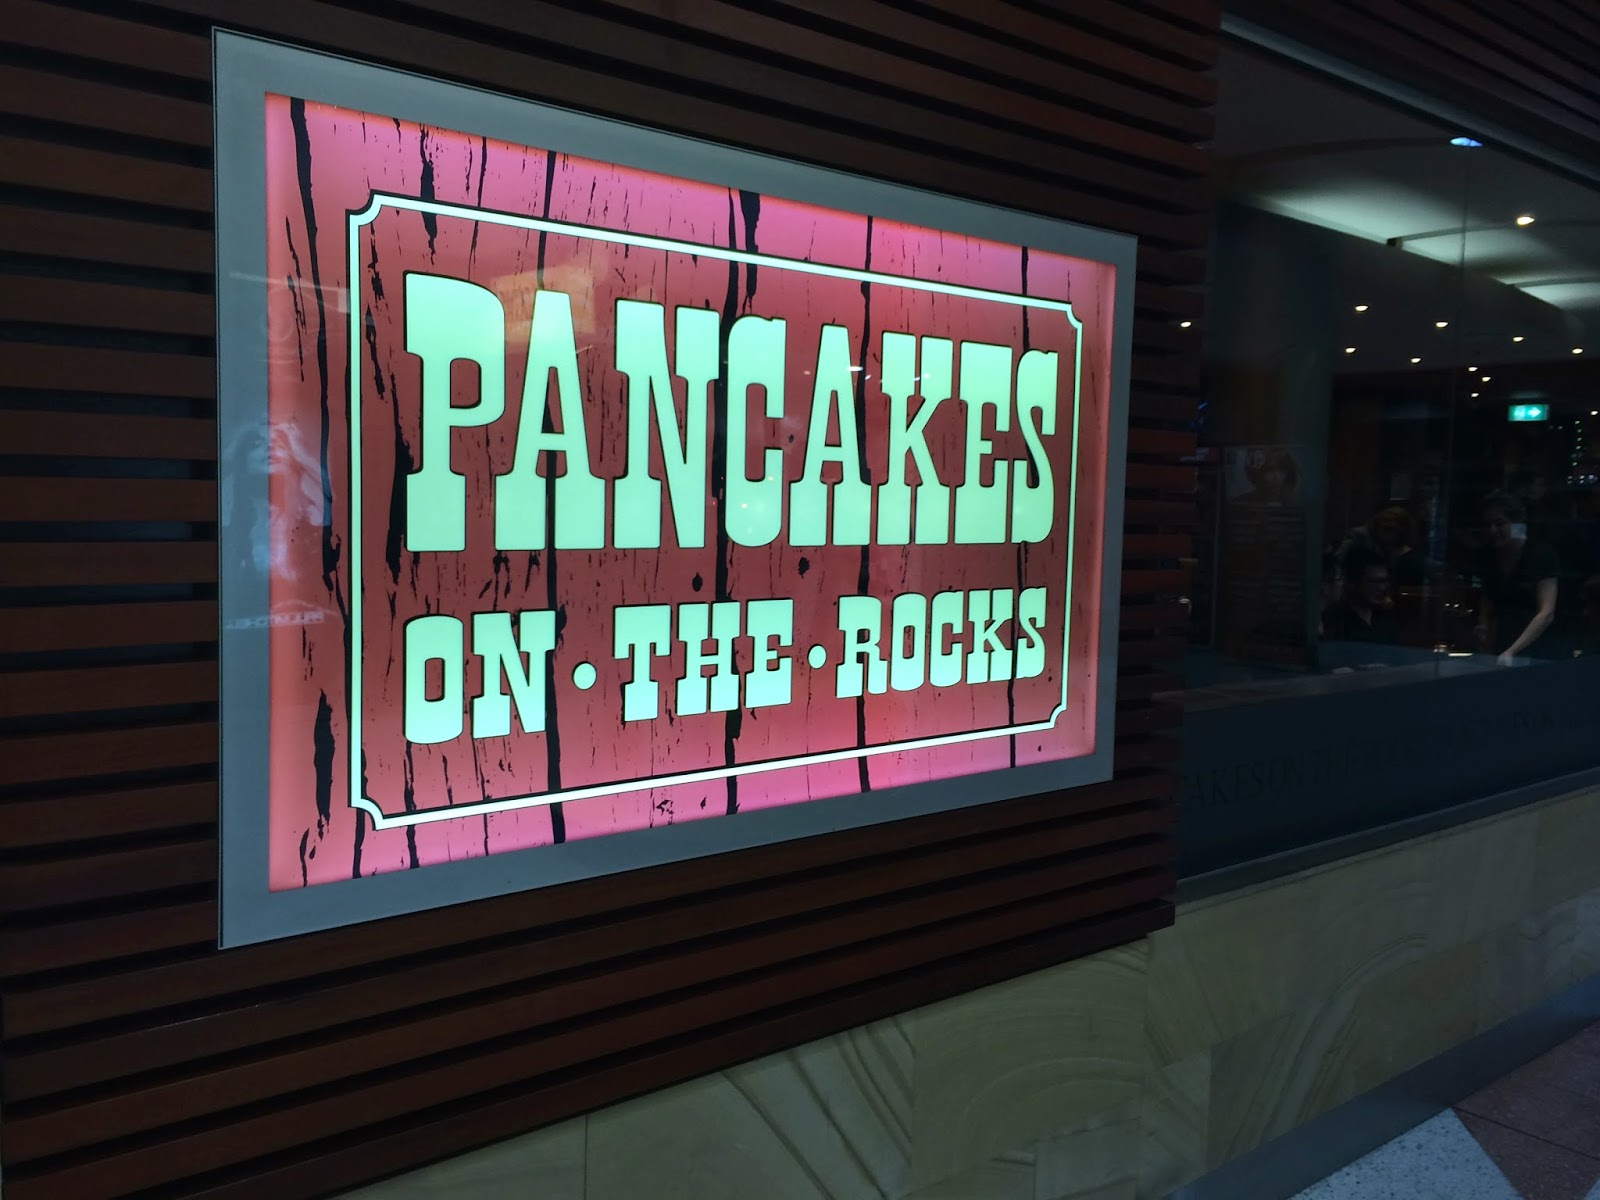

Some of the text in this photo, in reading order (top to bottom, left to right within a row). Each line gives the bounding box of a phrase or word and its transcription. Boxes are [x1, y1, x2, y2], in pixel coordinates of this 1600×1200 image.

[404, 272, 1059, 552] PANCAKES
[404, 586, 1047, 744] ON THE ROCKS
